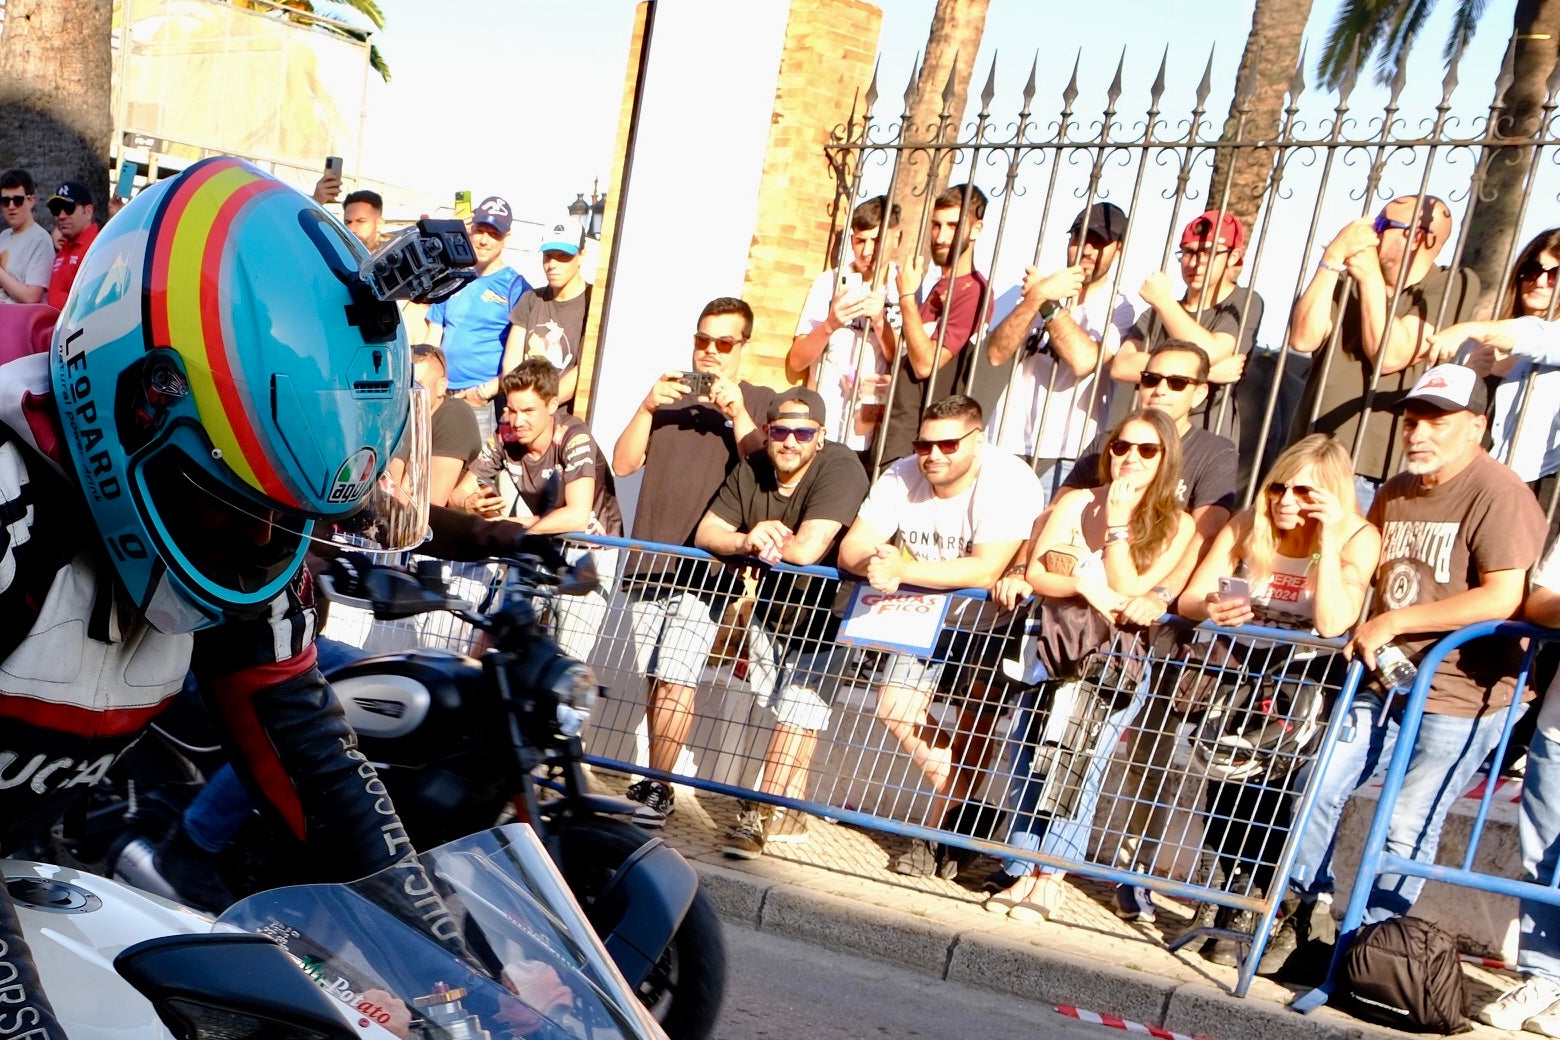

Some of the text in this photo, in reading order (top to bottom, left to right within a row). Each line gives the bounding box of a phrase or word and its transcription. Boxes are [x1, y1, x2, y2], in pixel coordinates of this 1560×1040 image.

[65, 328, 121, 501] LEOPARD
[332, 484, 361, 501] agv
[326, 977, 391, 1025] Potato
